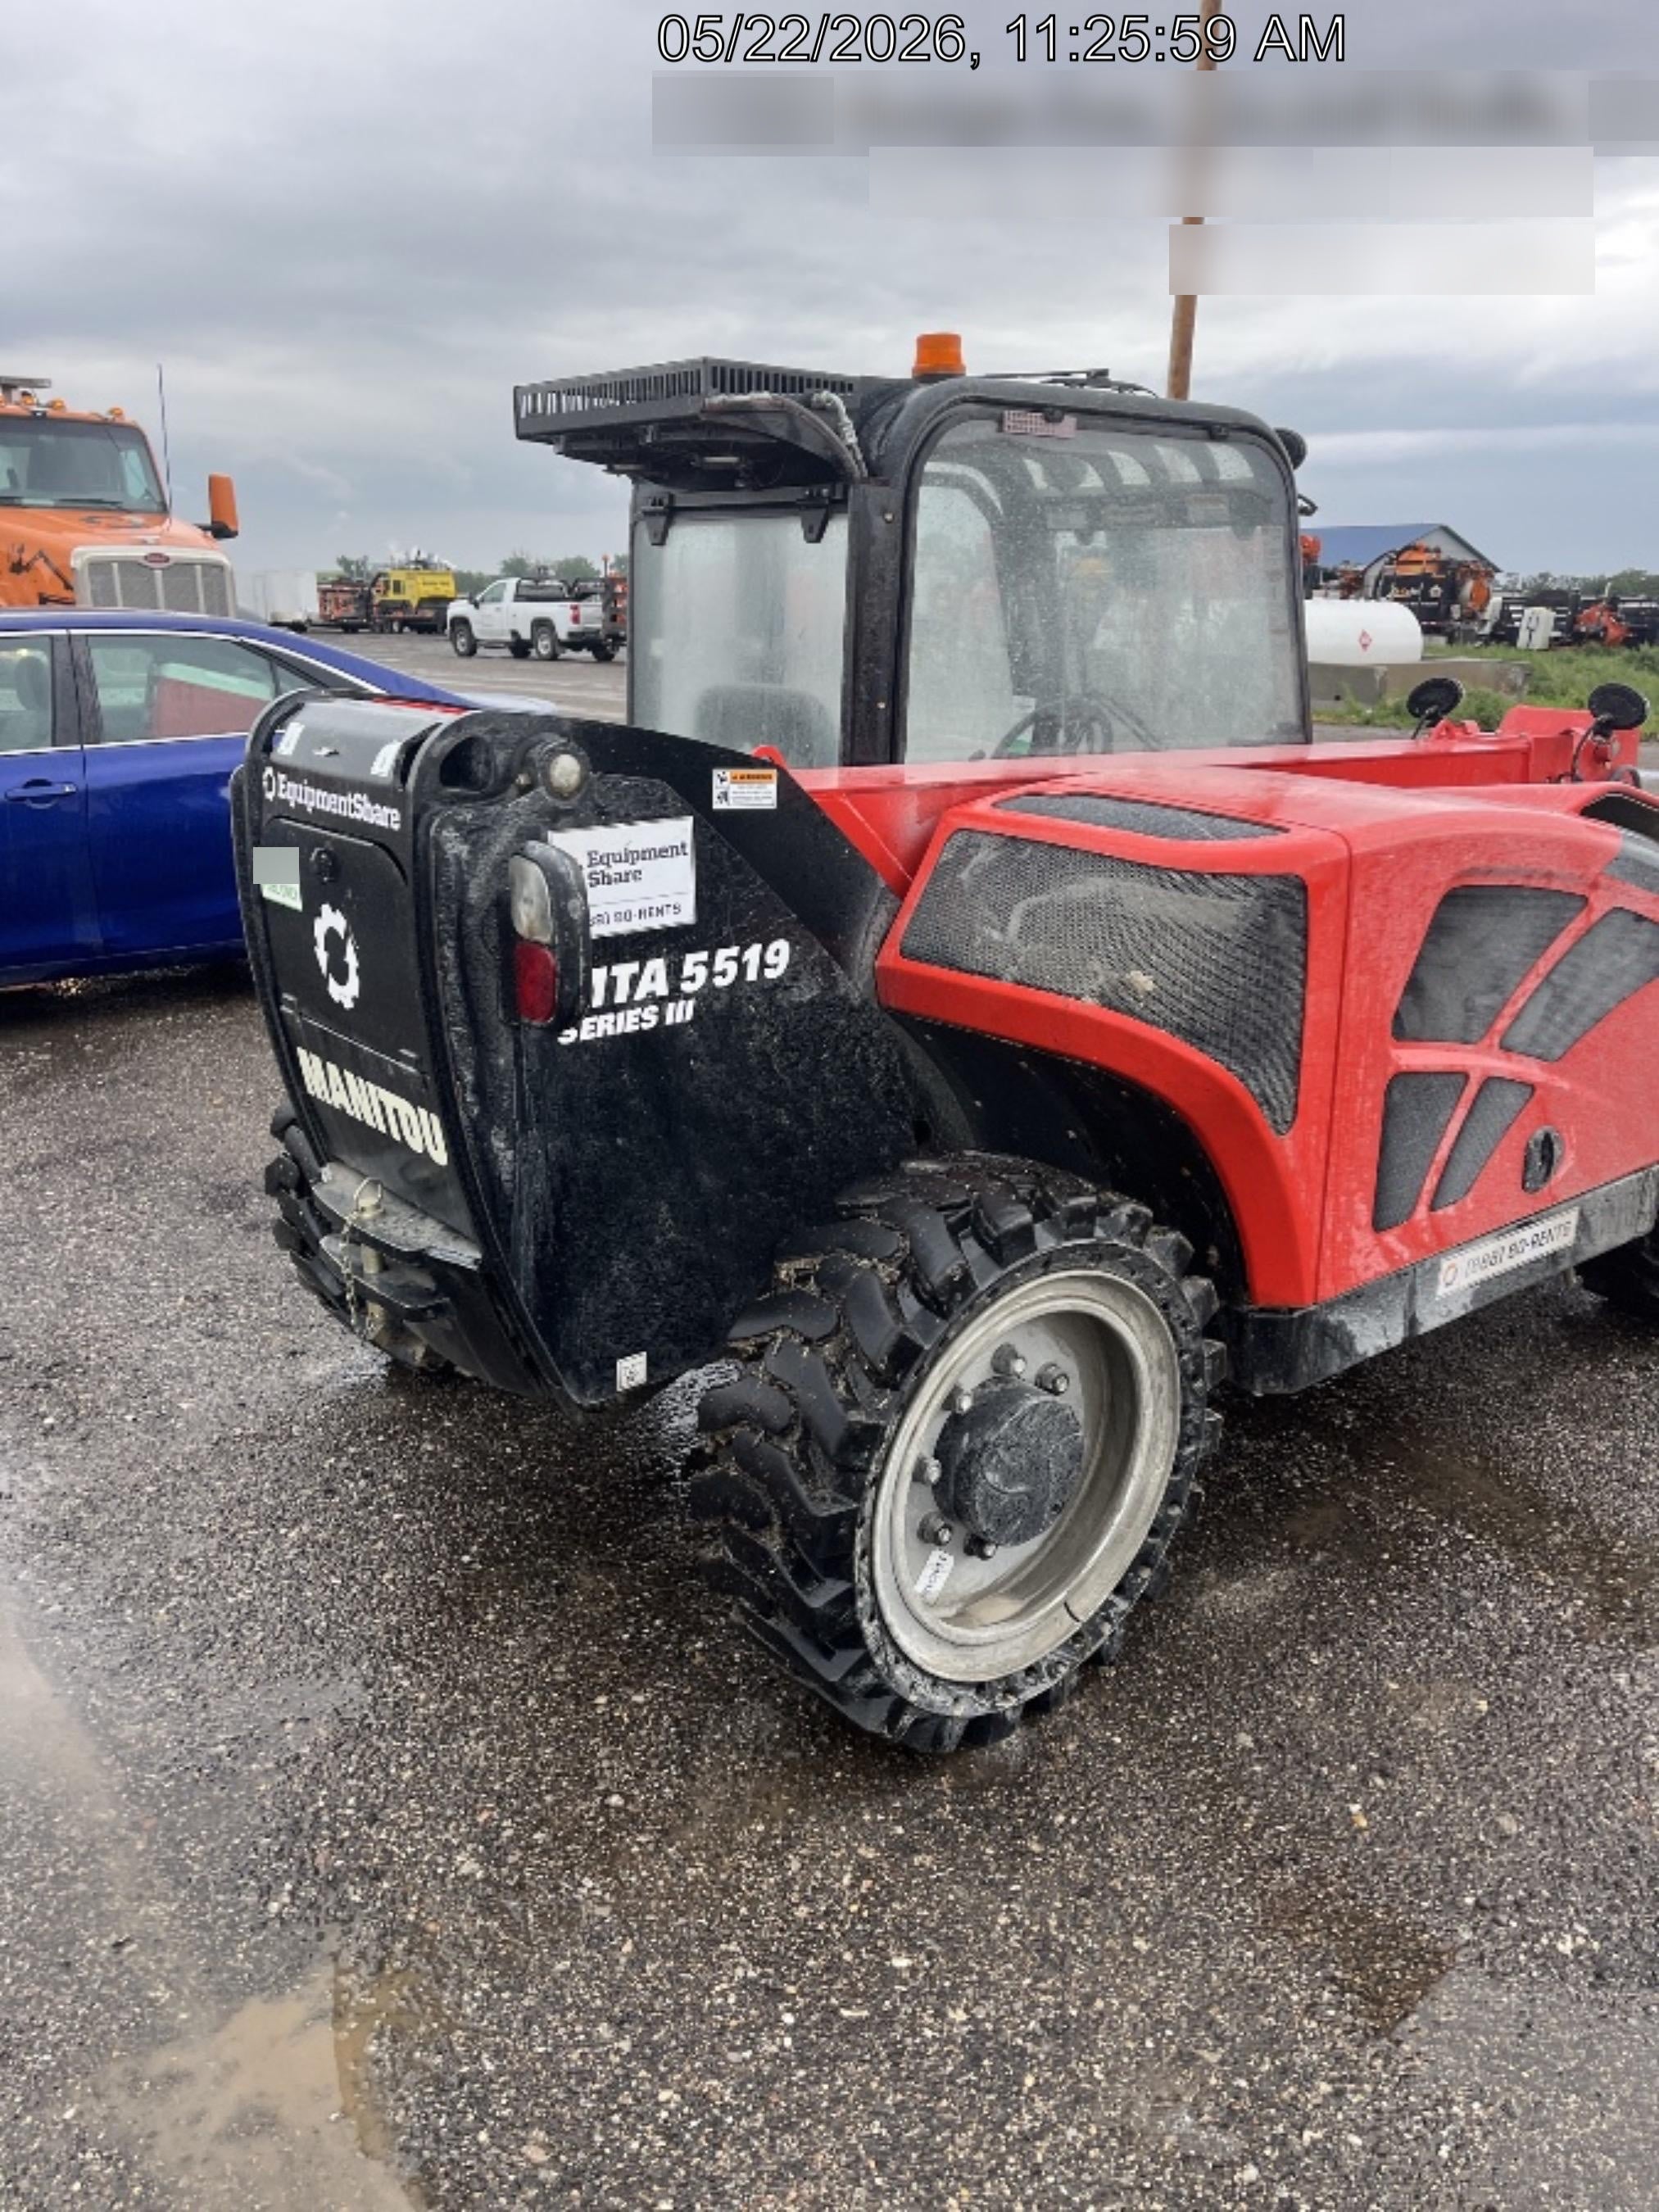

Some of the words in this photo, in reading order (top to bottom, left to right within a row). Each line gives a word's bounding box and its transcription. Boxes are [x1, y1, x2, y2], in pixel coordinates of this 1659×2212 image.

[278, 773, 401, 831] EquipmentShare
[587, 841, 688, 869] Equipment
[587, 868, 643, 887] Share
[680, 938, 791, 994] 5519
[665, 999, 695, 1026] III
[297, 1046, 448, 1166] MANITOU
